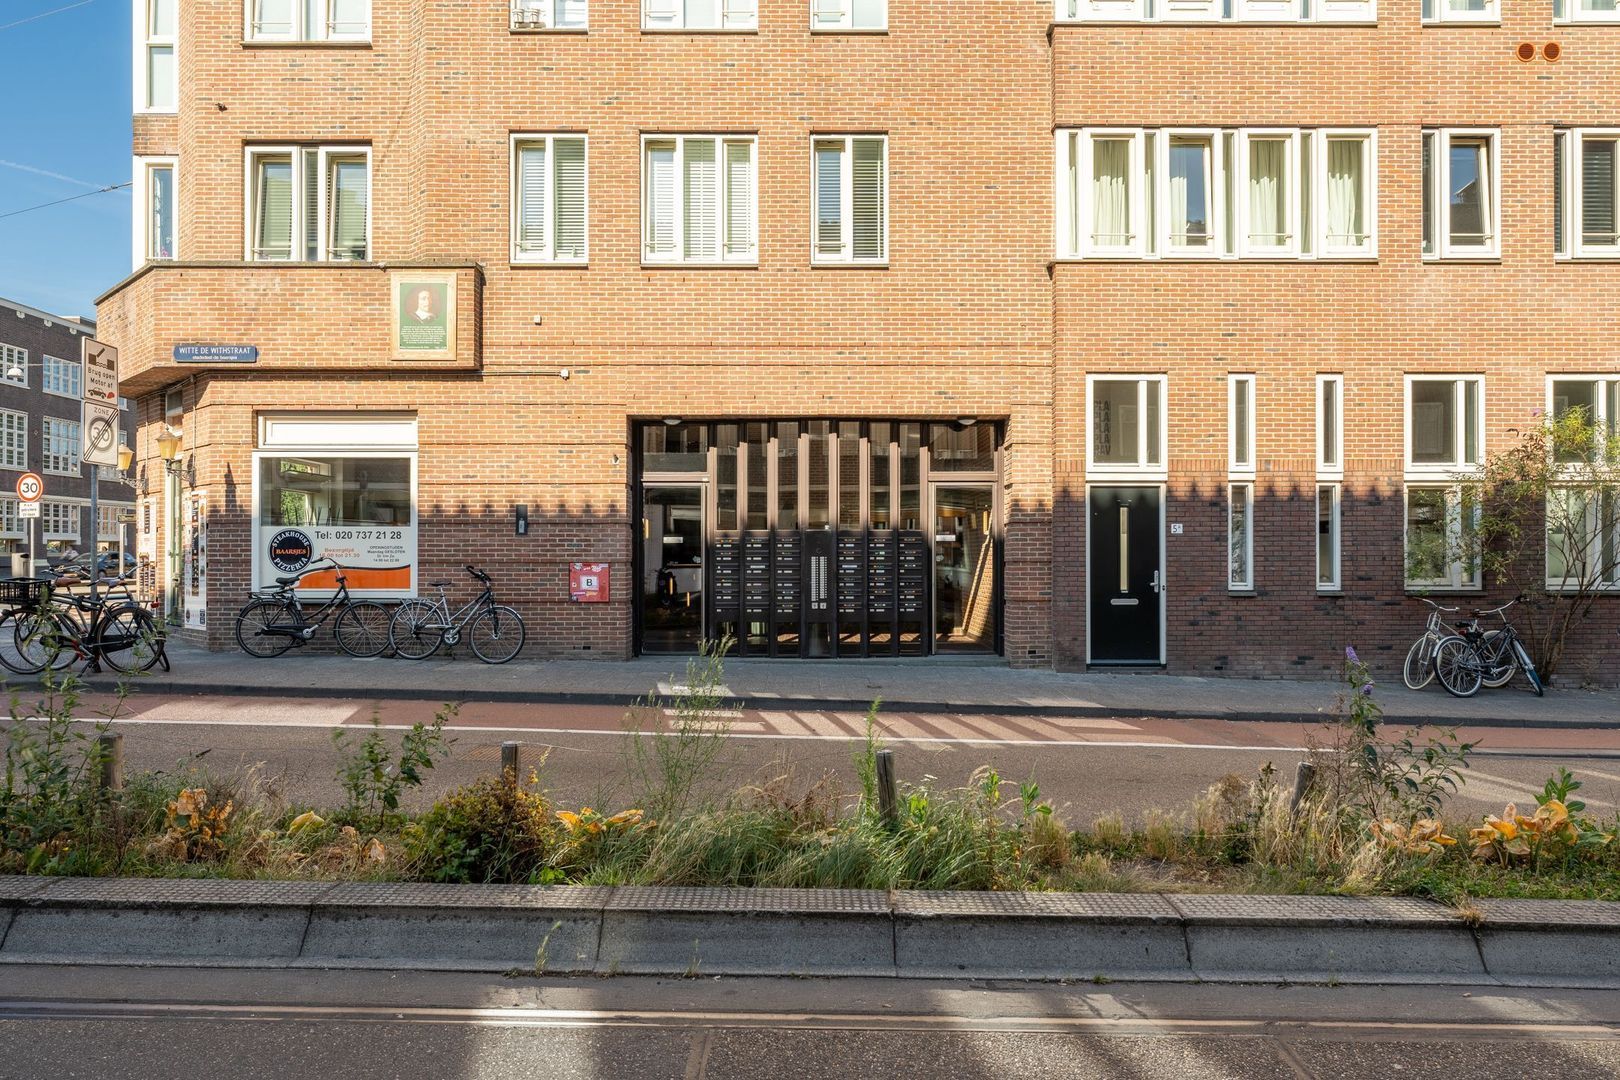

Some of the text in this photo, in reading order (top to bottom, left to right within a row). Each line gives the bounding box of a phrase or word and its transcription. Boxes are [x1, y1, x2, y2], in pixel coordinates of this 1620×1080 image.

[179, 346, 251, 354] WITTE DE WITHSTRAAT
[88, 366, 115, 381] Brug open
[90, 377, 107, 387] Motor
[94, 407, 110, 416] ZONE
[22, 483, 38, 493] 30
[271, 531, 310, 547] STEAKHOUSE
[315, 531, 402, 540] Tel: 020 737 21 28
[273, 557, 309, 571] PIZZERIA
